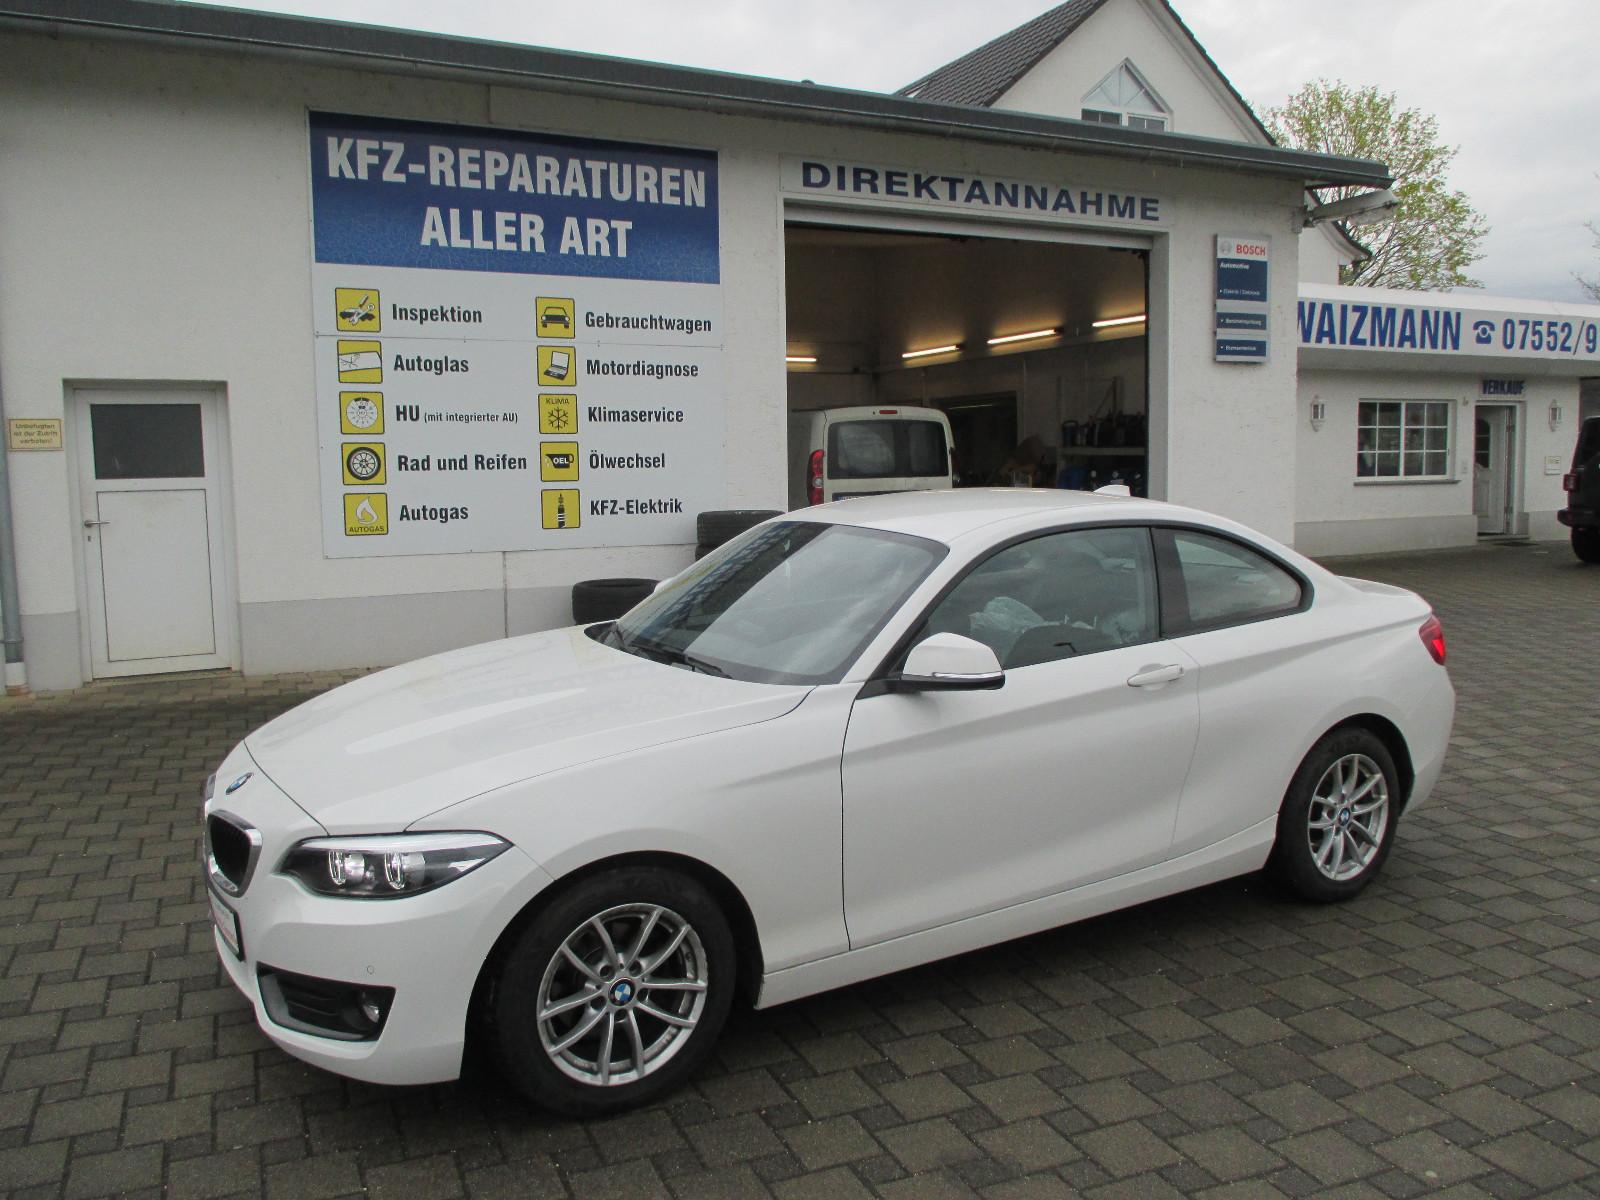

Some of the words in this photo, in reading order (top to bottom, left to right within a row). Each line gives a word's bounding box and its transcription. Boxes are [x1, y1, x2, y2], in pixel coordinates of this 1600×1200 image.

[327, 136, 706, 208] KFZ-REPARATUREN
[802, 161, 1160, 221] DIREKTANNAHME
[420, 206, 545, 253] ALLER
[560, 216, 633, 257] ART
[1236, 244, 1266, 256] BOSCH
[392, 304, 482, 325] Inspektion
[585, 312, 712, 334] Gebrauchtwagen
[1502, 318, 1598, 355] 07552/9
[393, 354, 469, 375] Autoglas
[586, 359, 699, 379] Motordiagnose
[1482, 379, 1525, 395] VERKAUF
[396, 405, 420, 422] HU
[424, 412, 443, 423] (mit
[446, 412, 499, 424] integrierter
[502, 412, 518, 423] AU)
[588, 406, 684, 422] Klimaservice
[397, 455, 431, 471] Rad
[437, 454, 468, 471] und
[474, 454, 527, 470] Reifen
[553, 457, 569, 465] OEL
[589, 450, 666, 469] Ölwechsel
[399, 505, 469, 524] Autogas
[590, 498, 683, 515] KFZ-Elektrik
[349, 525, 385, 533] AUTOGAS
